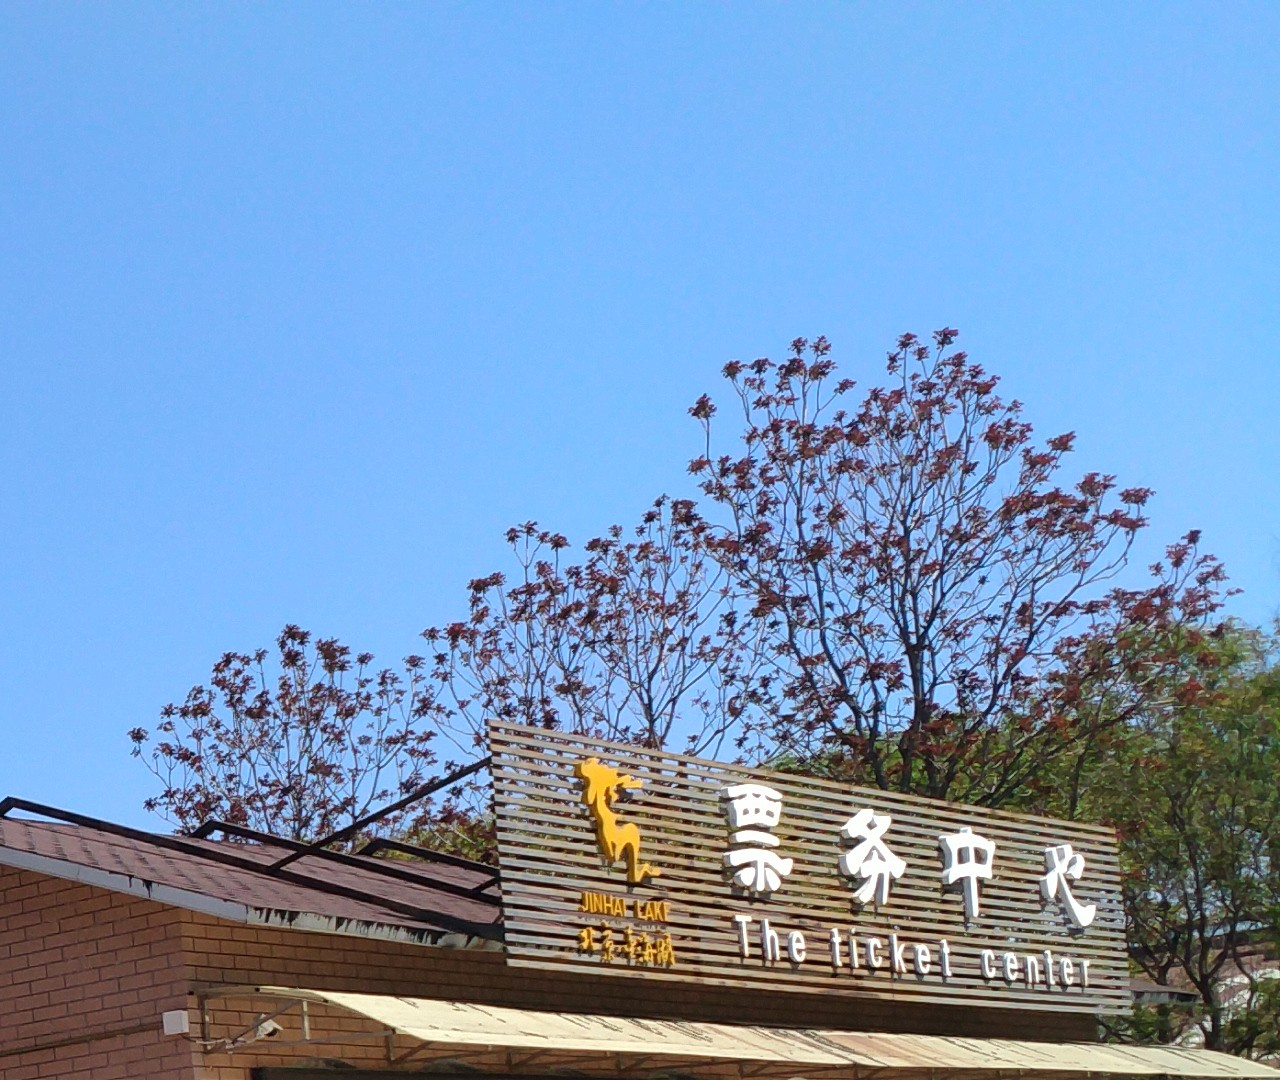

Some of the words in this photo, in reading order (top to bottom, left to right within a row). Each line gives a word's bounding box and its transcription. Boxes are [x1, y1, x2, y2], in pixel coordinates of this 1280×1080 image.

[722, 783, 1097, 929] 票务中心
[578, 891, 627, 917] JINHAI
[633, 899, 672, 922] LAKE
[734, 914, 806, 964] The
[830, 926, 954, 979] ticket
[981, 948, 1091, 988] center
